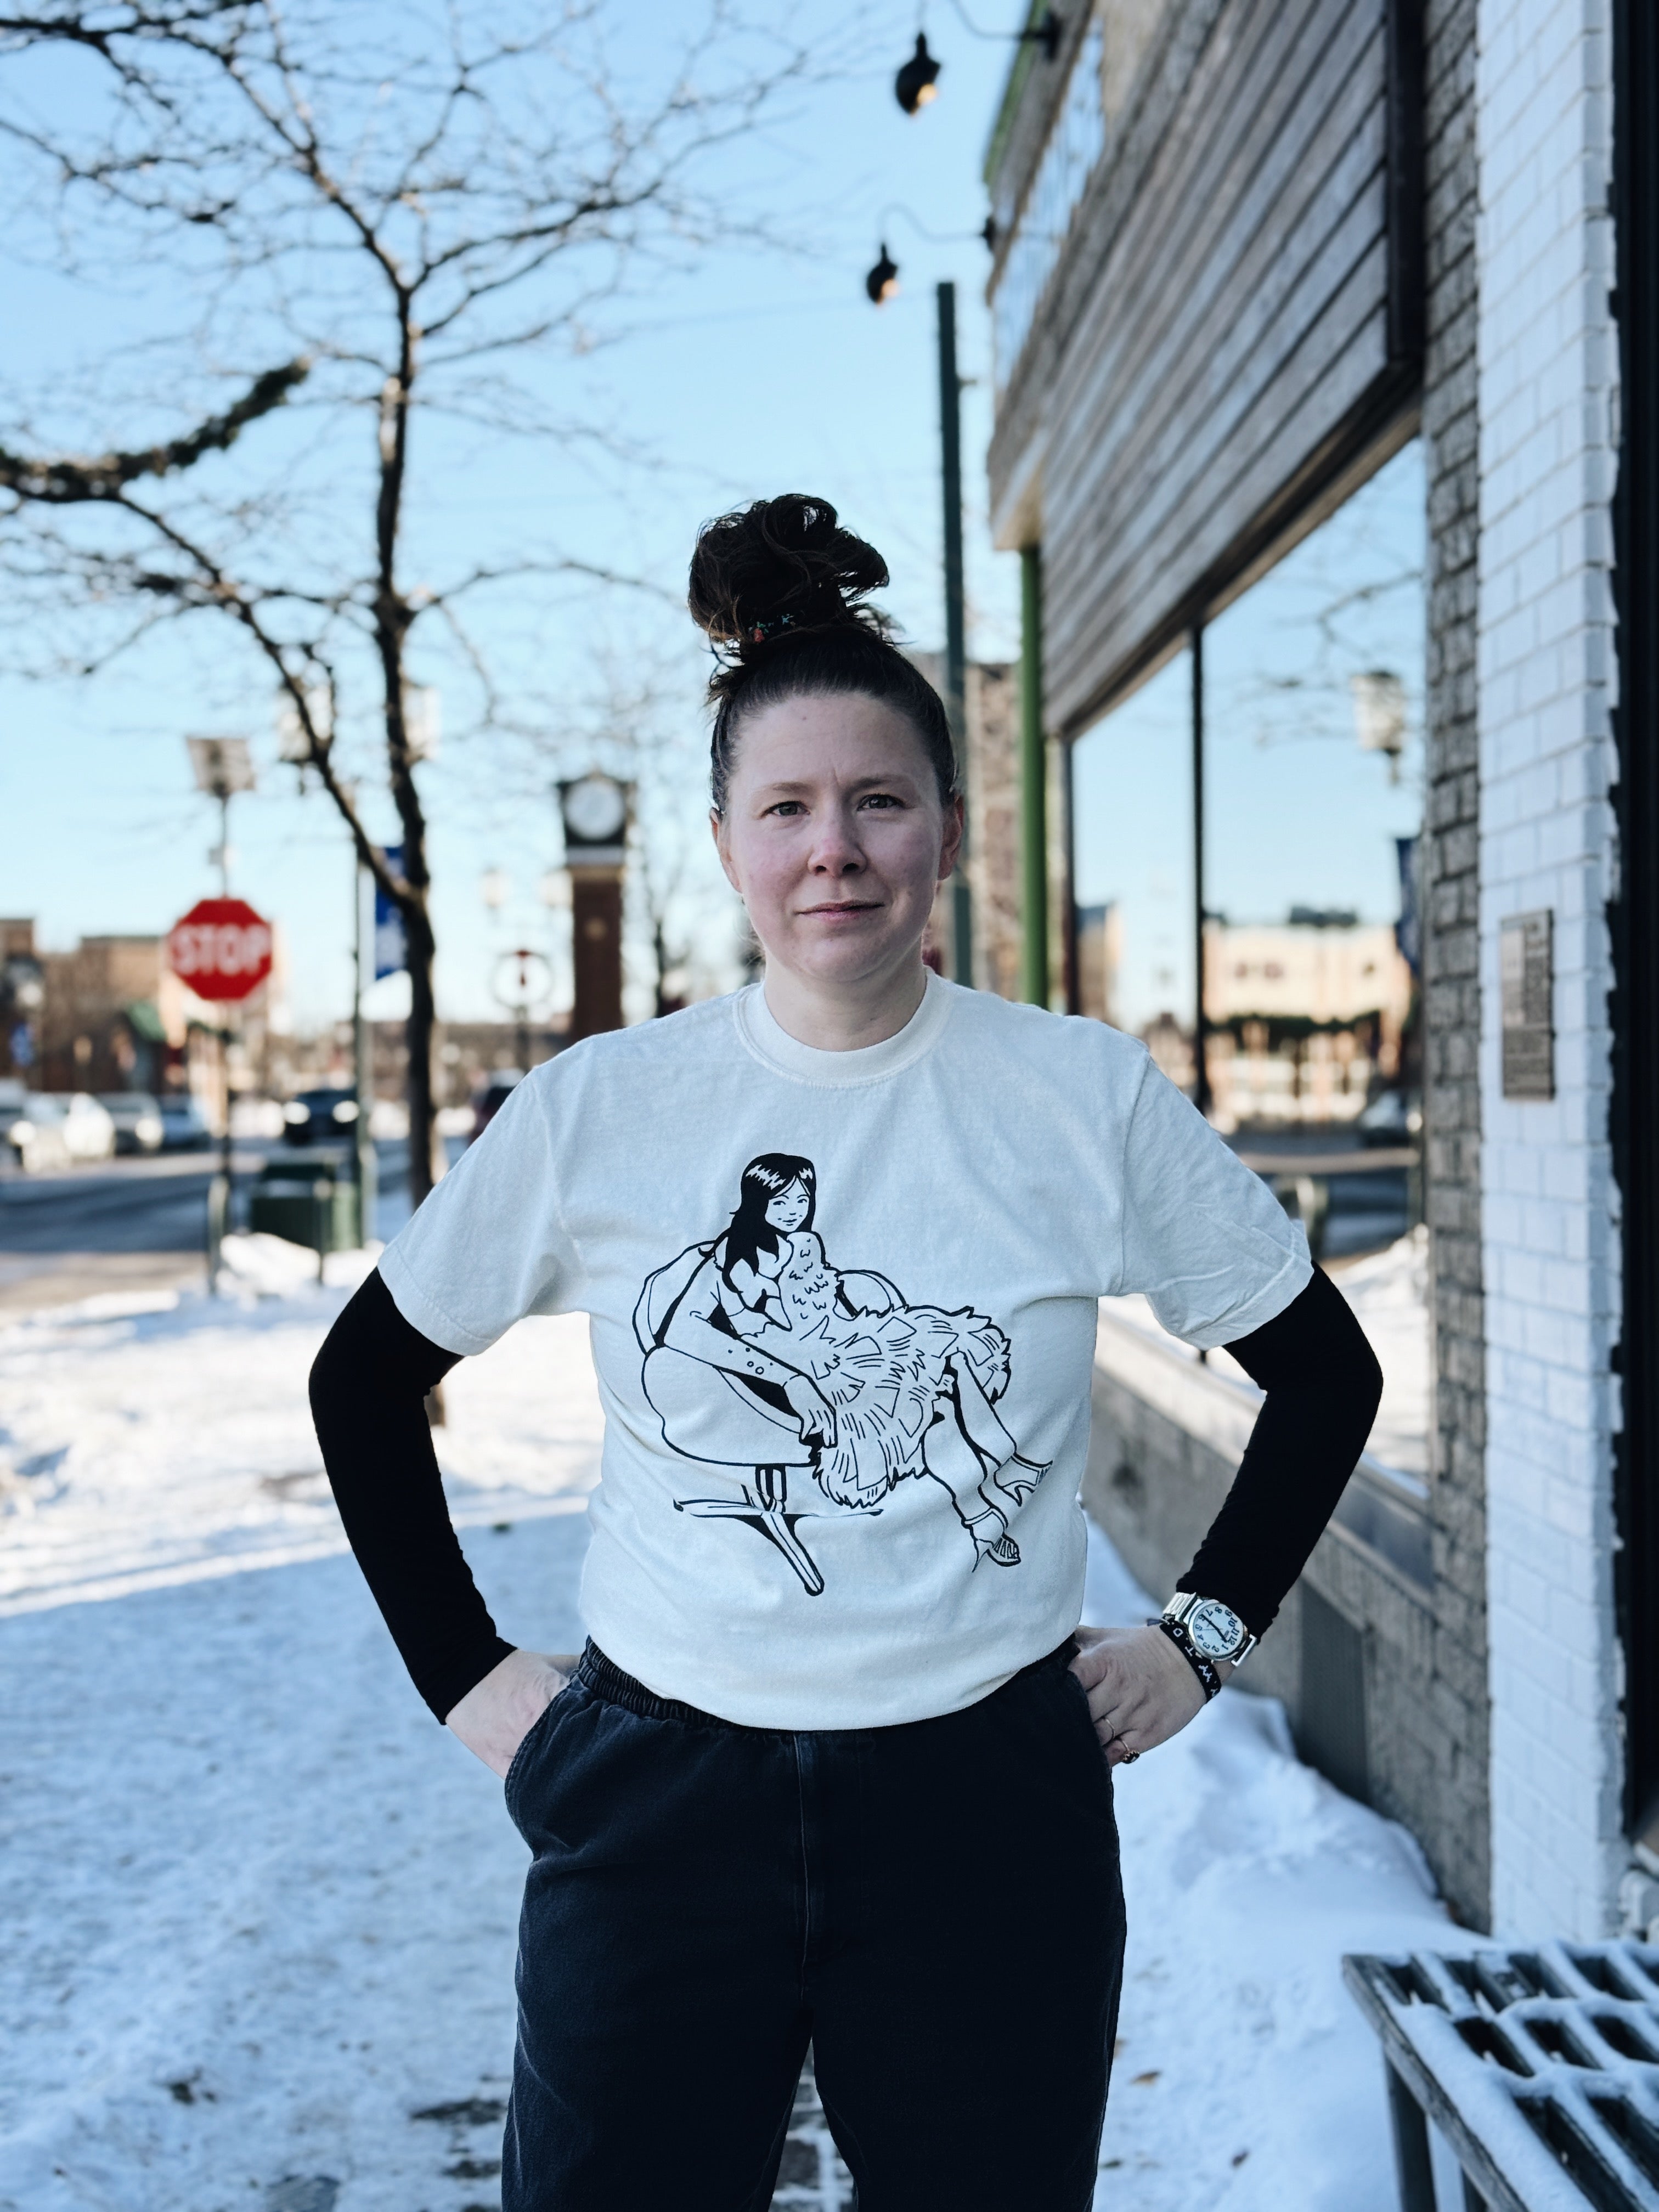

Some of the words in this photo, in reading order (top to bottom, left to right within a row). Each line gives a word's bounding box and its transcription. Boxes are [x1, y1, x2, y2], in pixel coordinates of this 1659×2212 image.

[171, 924, 270, 975] STOP
[1228, 1617, 1238, 1627] 10
[1231, 1627, 1240, 1635] 11
[1228, 1635, 1237, 1645] 12
